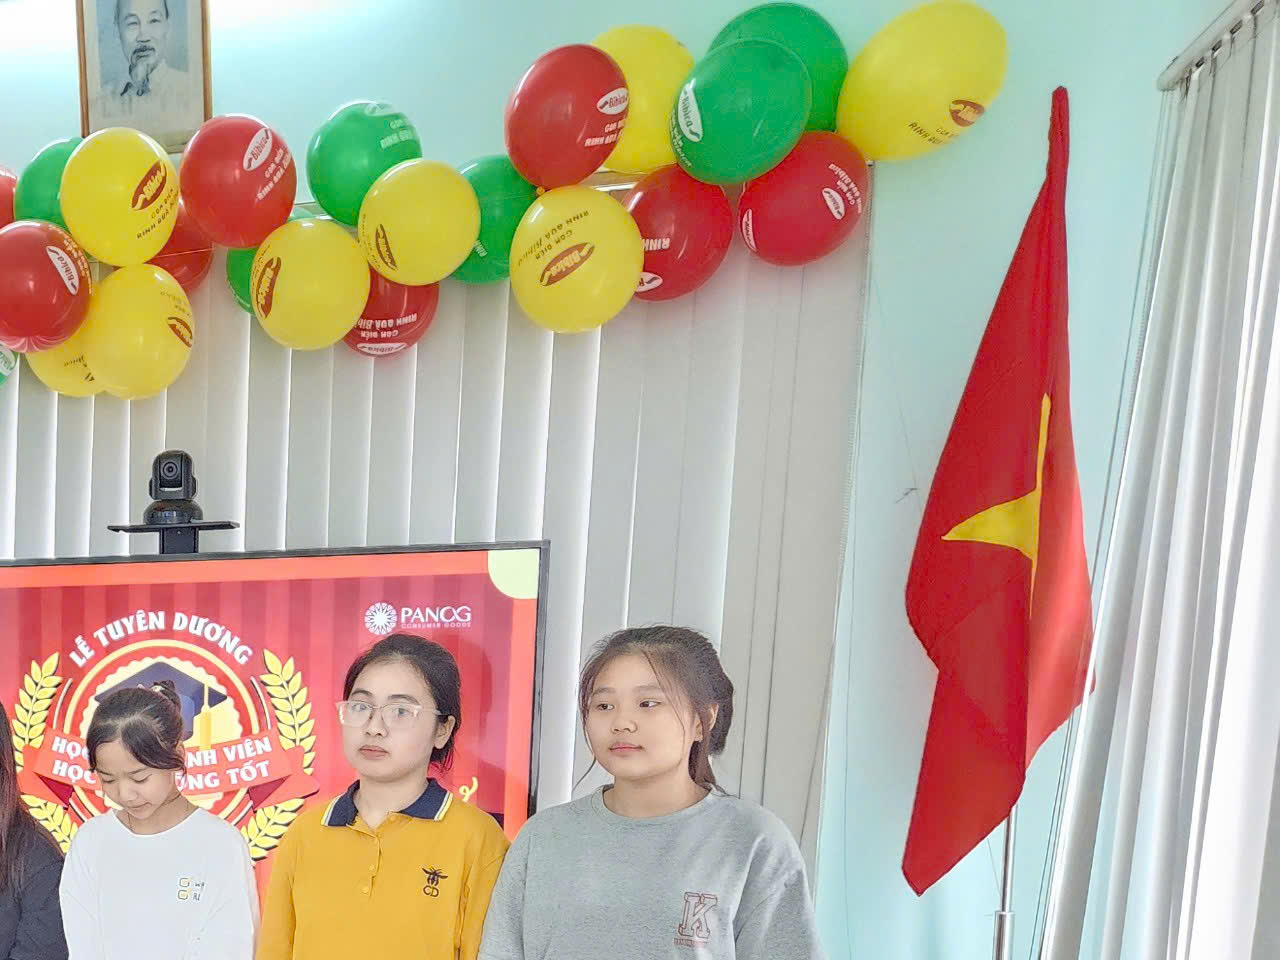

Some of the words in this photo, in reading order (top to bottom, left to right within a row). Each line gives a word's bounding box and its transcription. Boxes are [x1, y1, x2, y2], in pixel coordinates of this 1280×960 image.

[566, 210, 590, 225] RINH
[396, 313, 417, 326] RINH
[70, 635, 95, 668] LỄ
[93, 610, 165, 648] TUYÊN
[173, 612, 253, 665] DƯƠNG
[187, 749, 217, 768] NH
[222, 736, 273, 762] VIÊN
[52, 760, 96, 784] HỌC
[226, 760, 269, 785] TỐT
